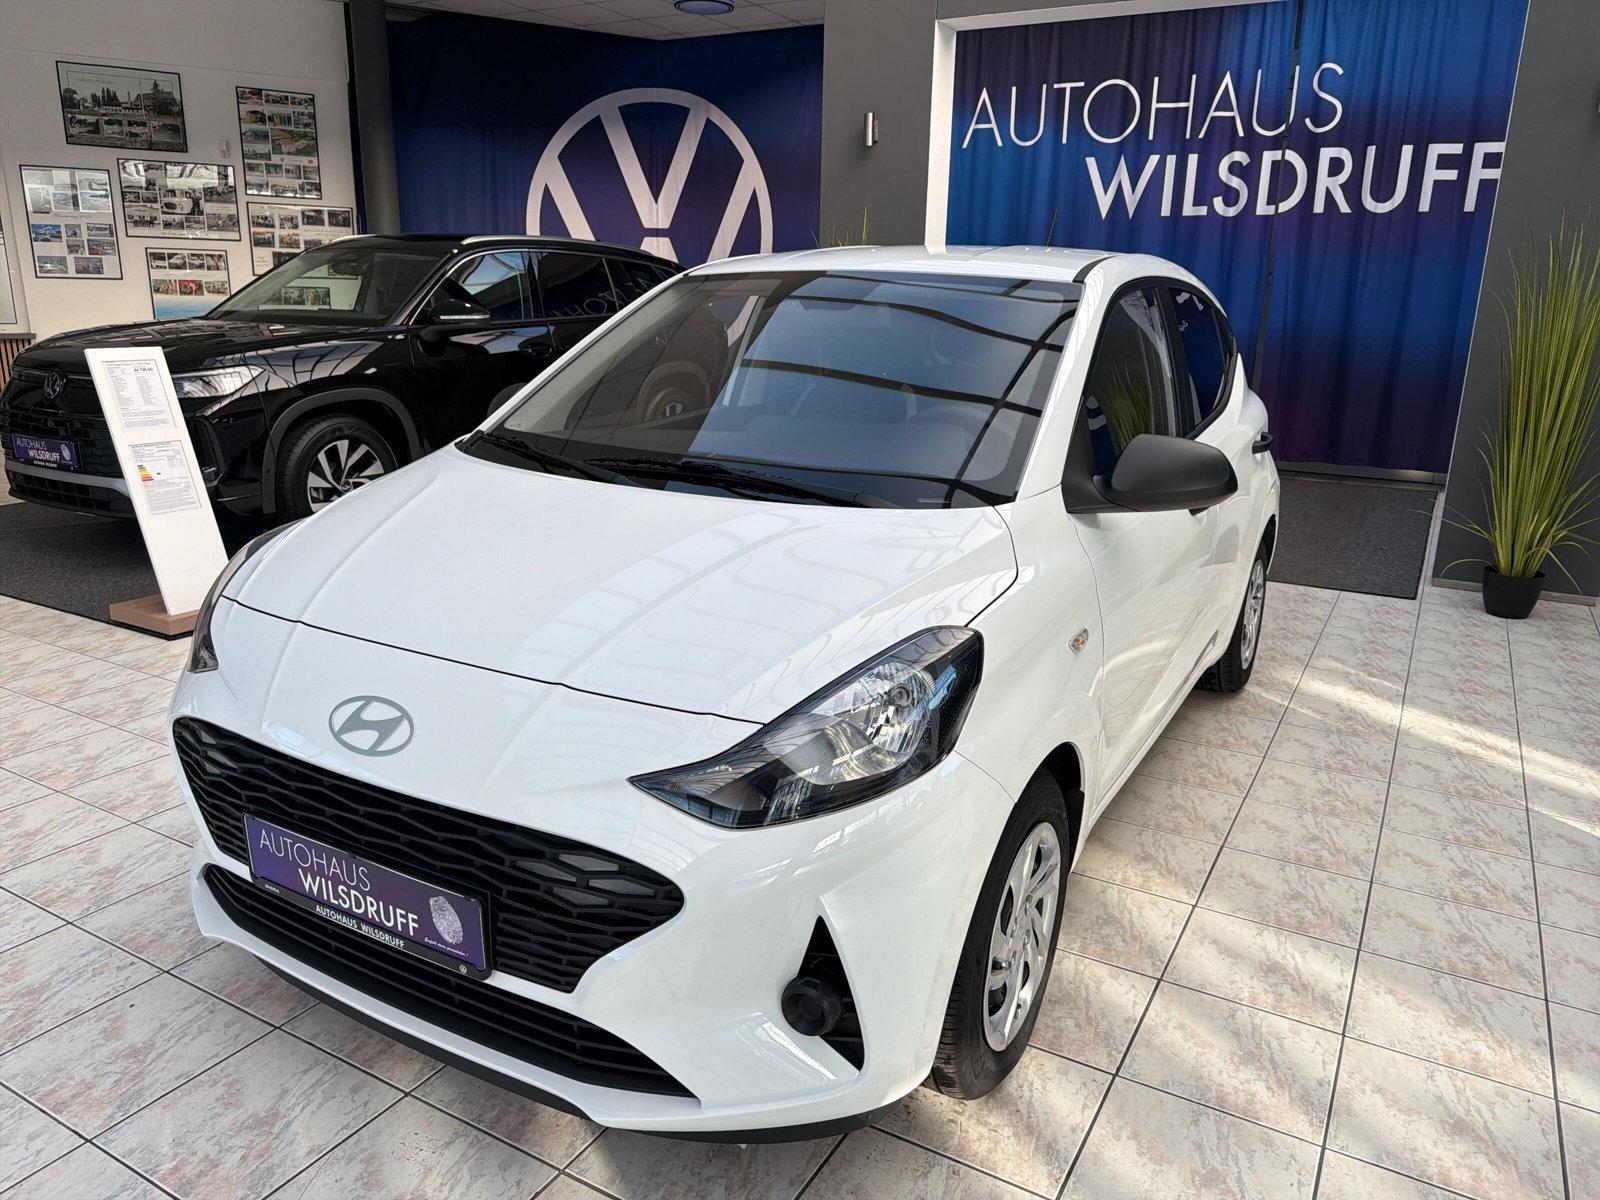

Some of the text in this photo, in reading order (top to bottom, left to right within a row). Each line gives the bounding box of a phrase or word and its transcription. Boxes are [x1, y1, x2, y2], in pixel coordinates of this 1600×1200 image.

[962, 62, 1344, 148] AUTOHAUS
[1085, 141, 1506, 220] WILSDRUFF
[16, 437, 48, 451] AUTOHAUS
[27, 448, 61, 462] WILSDRUFF
[259, 828, 371, 891] AUTOHAUS
[298, 867, 419, 937] WILSDRUFF
[315, 904, 358, 929] AUTOHAUS
[360, 922, 405, 949] WILSDRUFF
